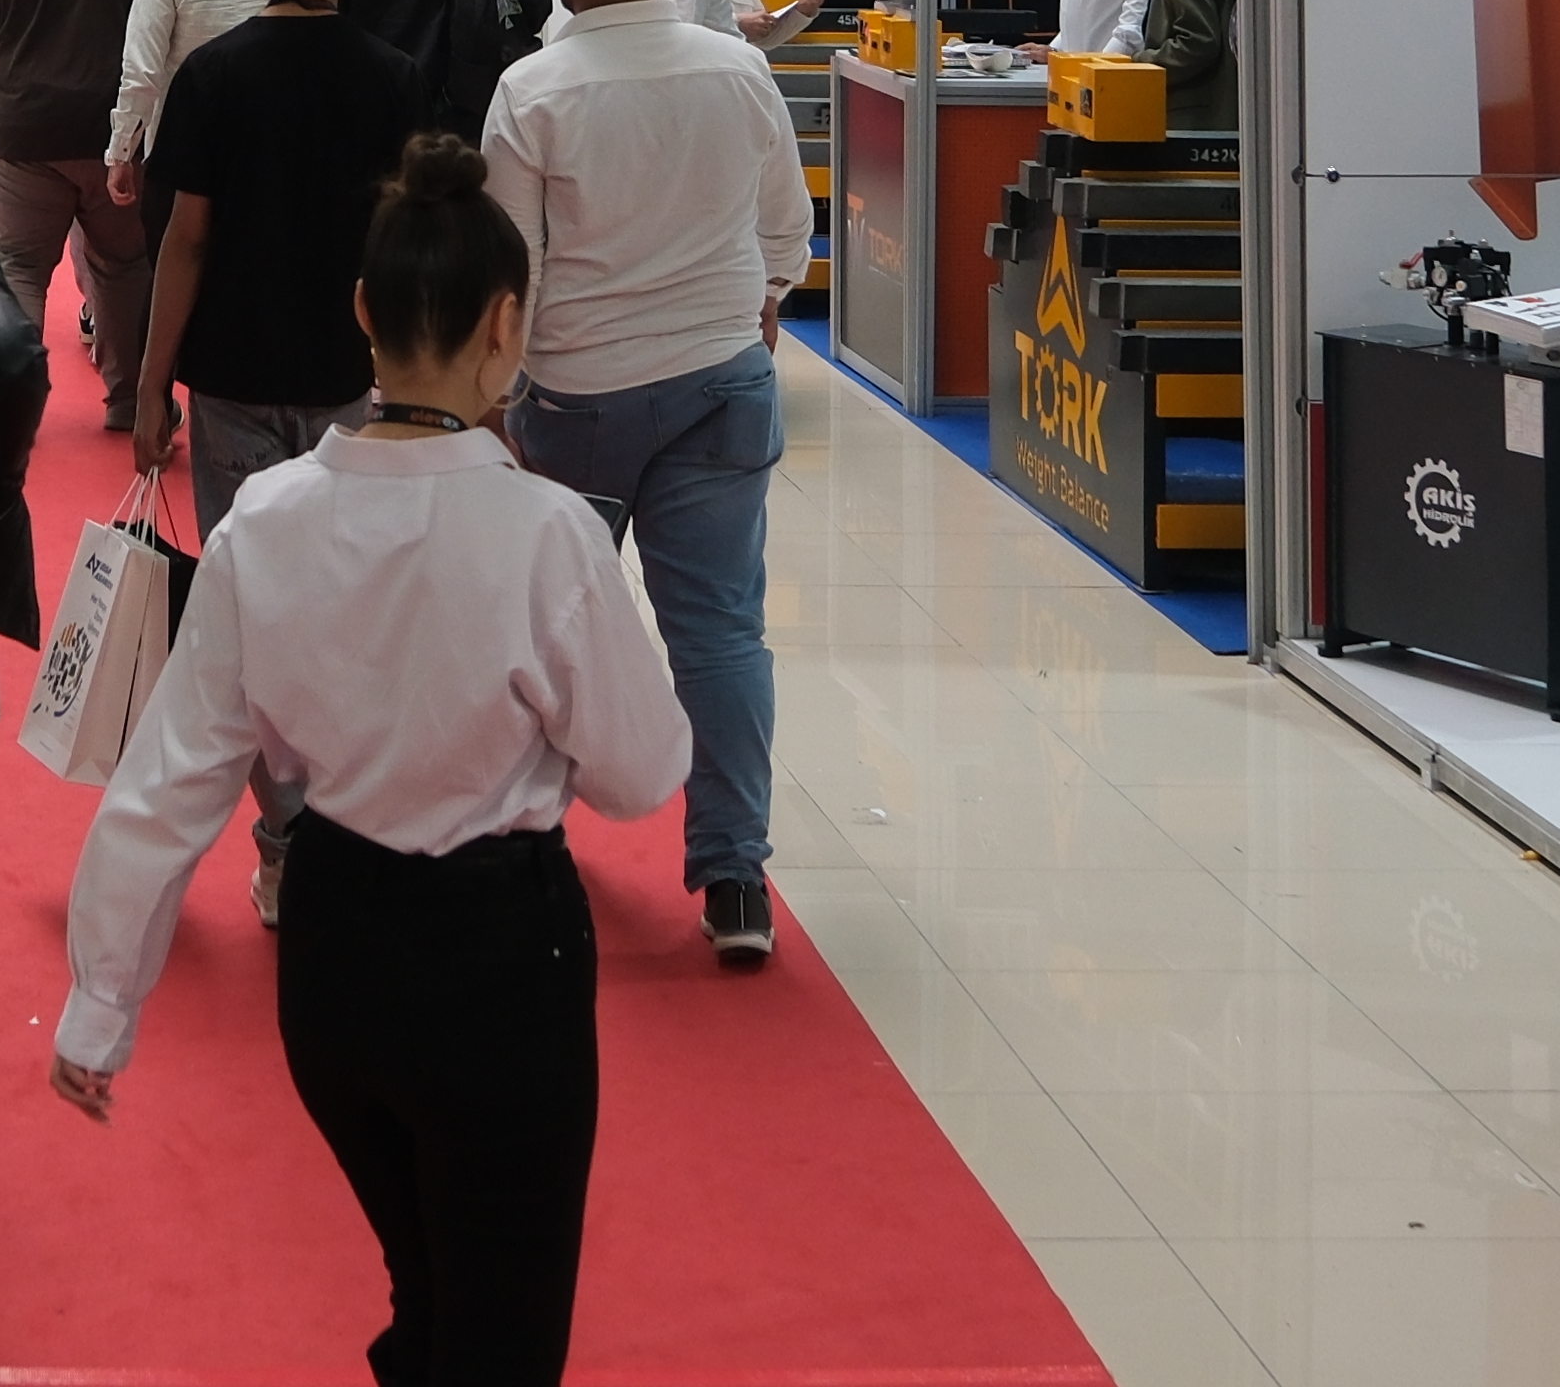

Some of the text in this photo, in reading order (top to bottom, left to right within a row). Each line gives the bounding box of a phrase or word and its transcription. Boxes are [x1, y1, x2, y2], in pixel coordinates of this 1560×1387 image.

[1189, 148, 1241, 163] 34±2K
[1014, 329, 1109, 476] TORK
[1015, 434, 1110, 534] Weight Balance
[1422, 485, 1477, 517] AKİŞ
[1422, 507, 1476, 529] HİDROLİK
